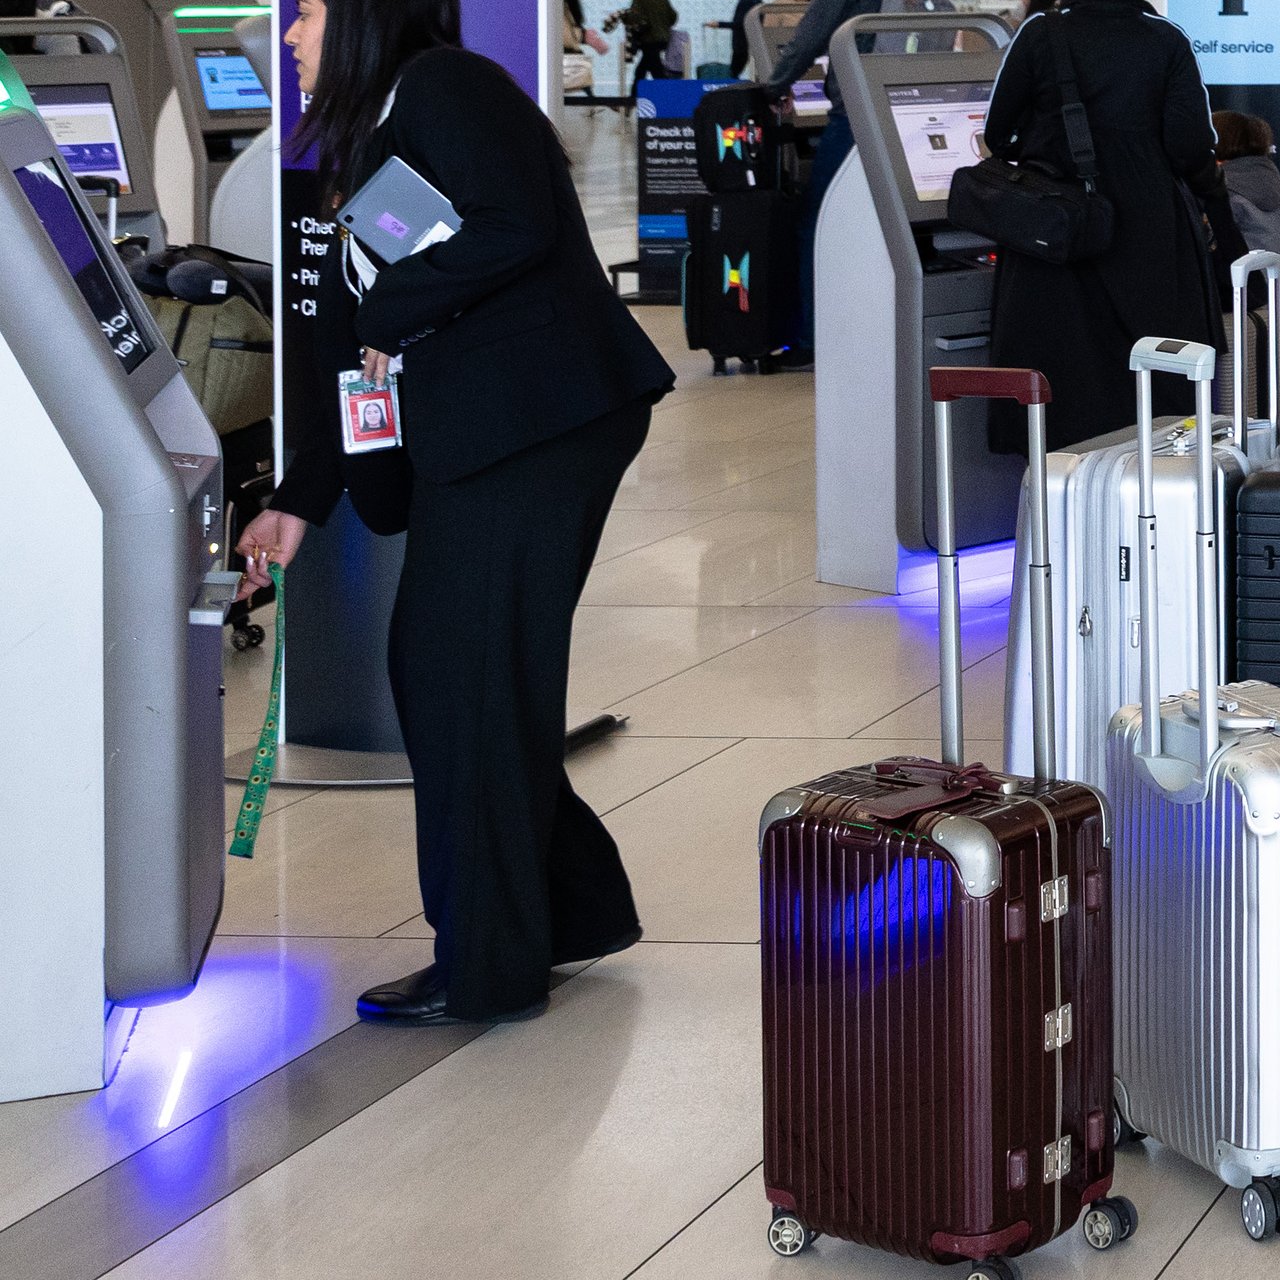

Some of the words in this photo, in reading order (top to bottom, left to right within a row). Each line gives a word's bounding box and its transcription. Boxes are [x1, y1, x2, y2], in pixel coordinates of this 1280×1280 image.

[1193, 40, 1219, 54] Self
[1221, 40, 1274, 54] service
[645, 126, 681, 137] Check
[645, 140, 658, 150] of
[659, 142, 683, 152] your
